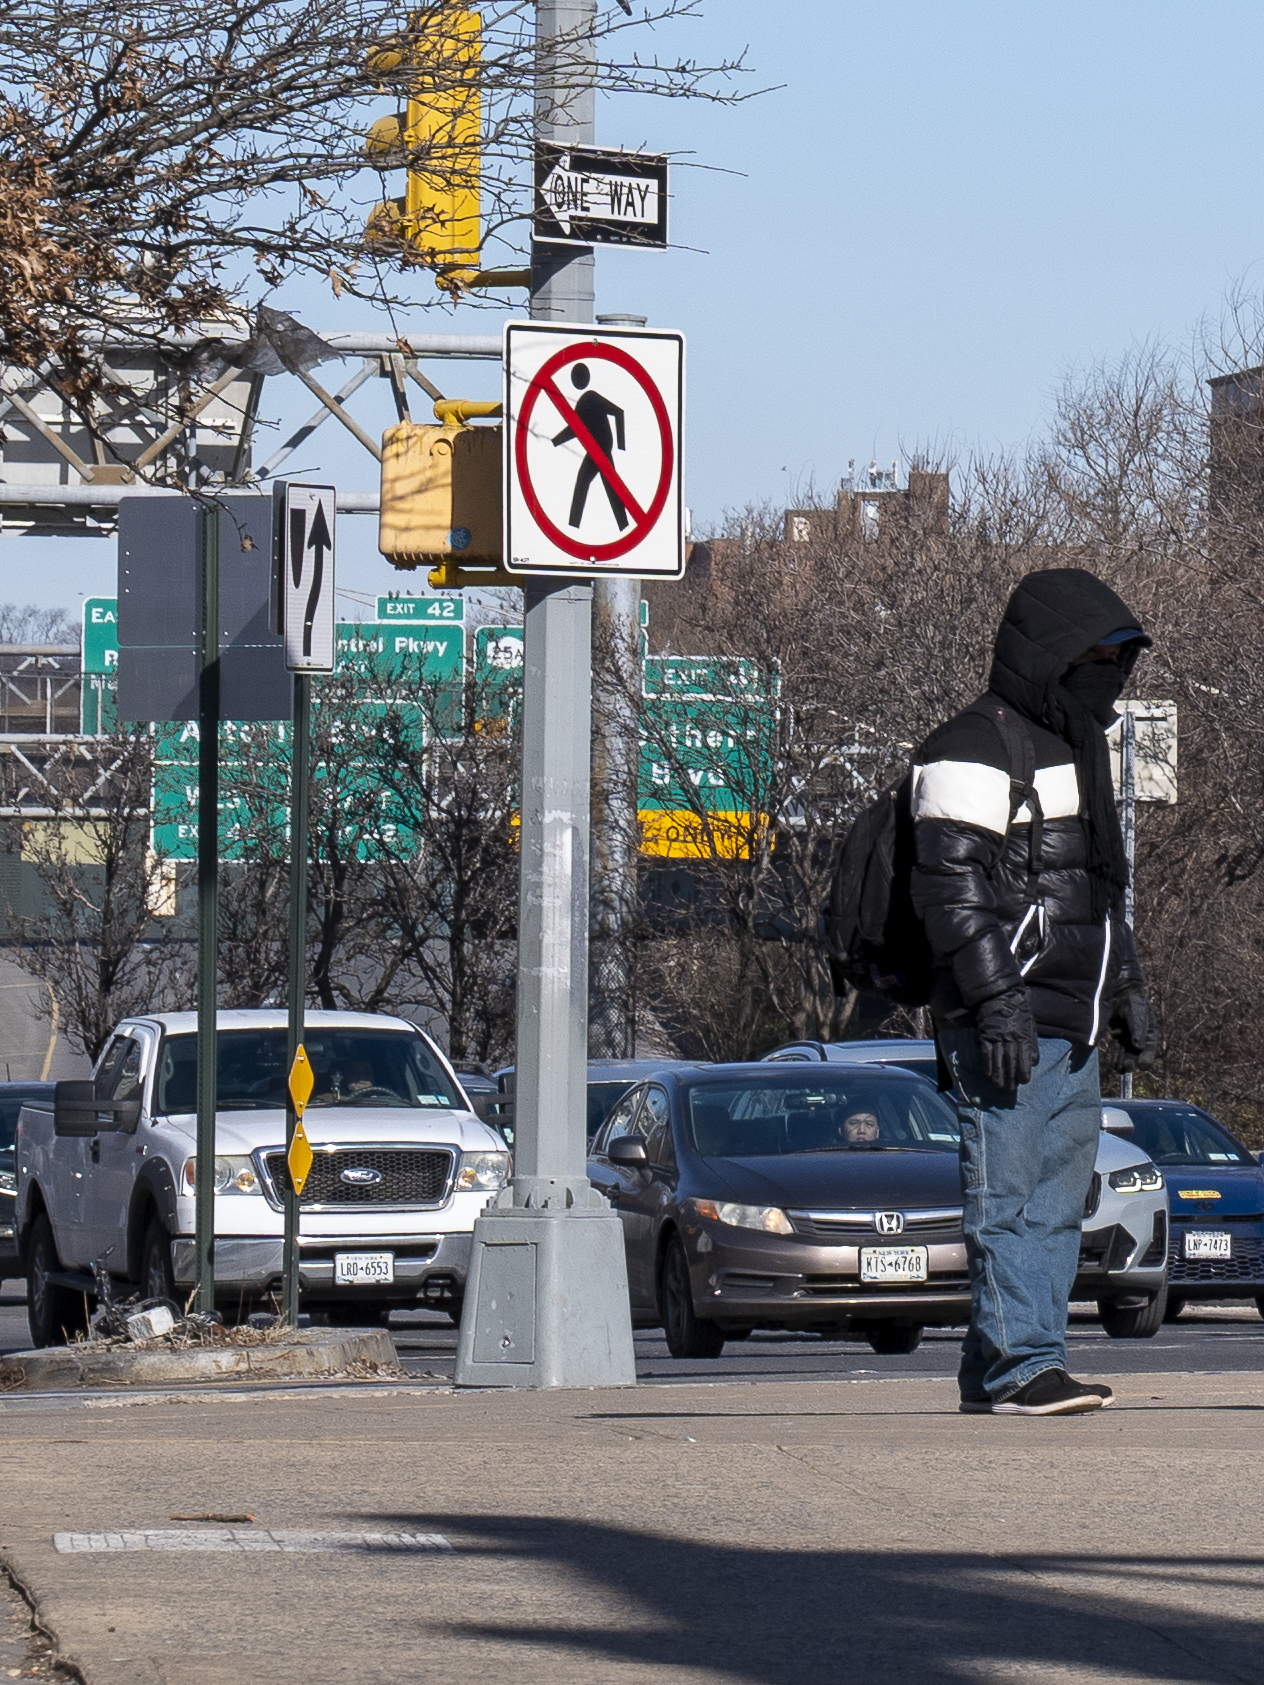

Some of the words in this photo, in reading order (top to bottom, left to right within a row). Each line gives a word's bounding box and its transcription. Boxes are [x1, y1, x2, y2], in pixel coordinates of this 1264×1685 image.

[554, 174, 591, 212] ONE
[609, 180, 650, 218] WAY
[91, 607, 118, 623] EA
[386, 602, 416, 614] EXIT
[427, 601, 455, 617] 42
[394, 637, 448, 657] Pkwy
